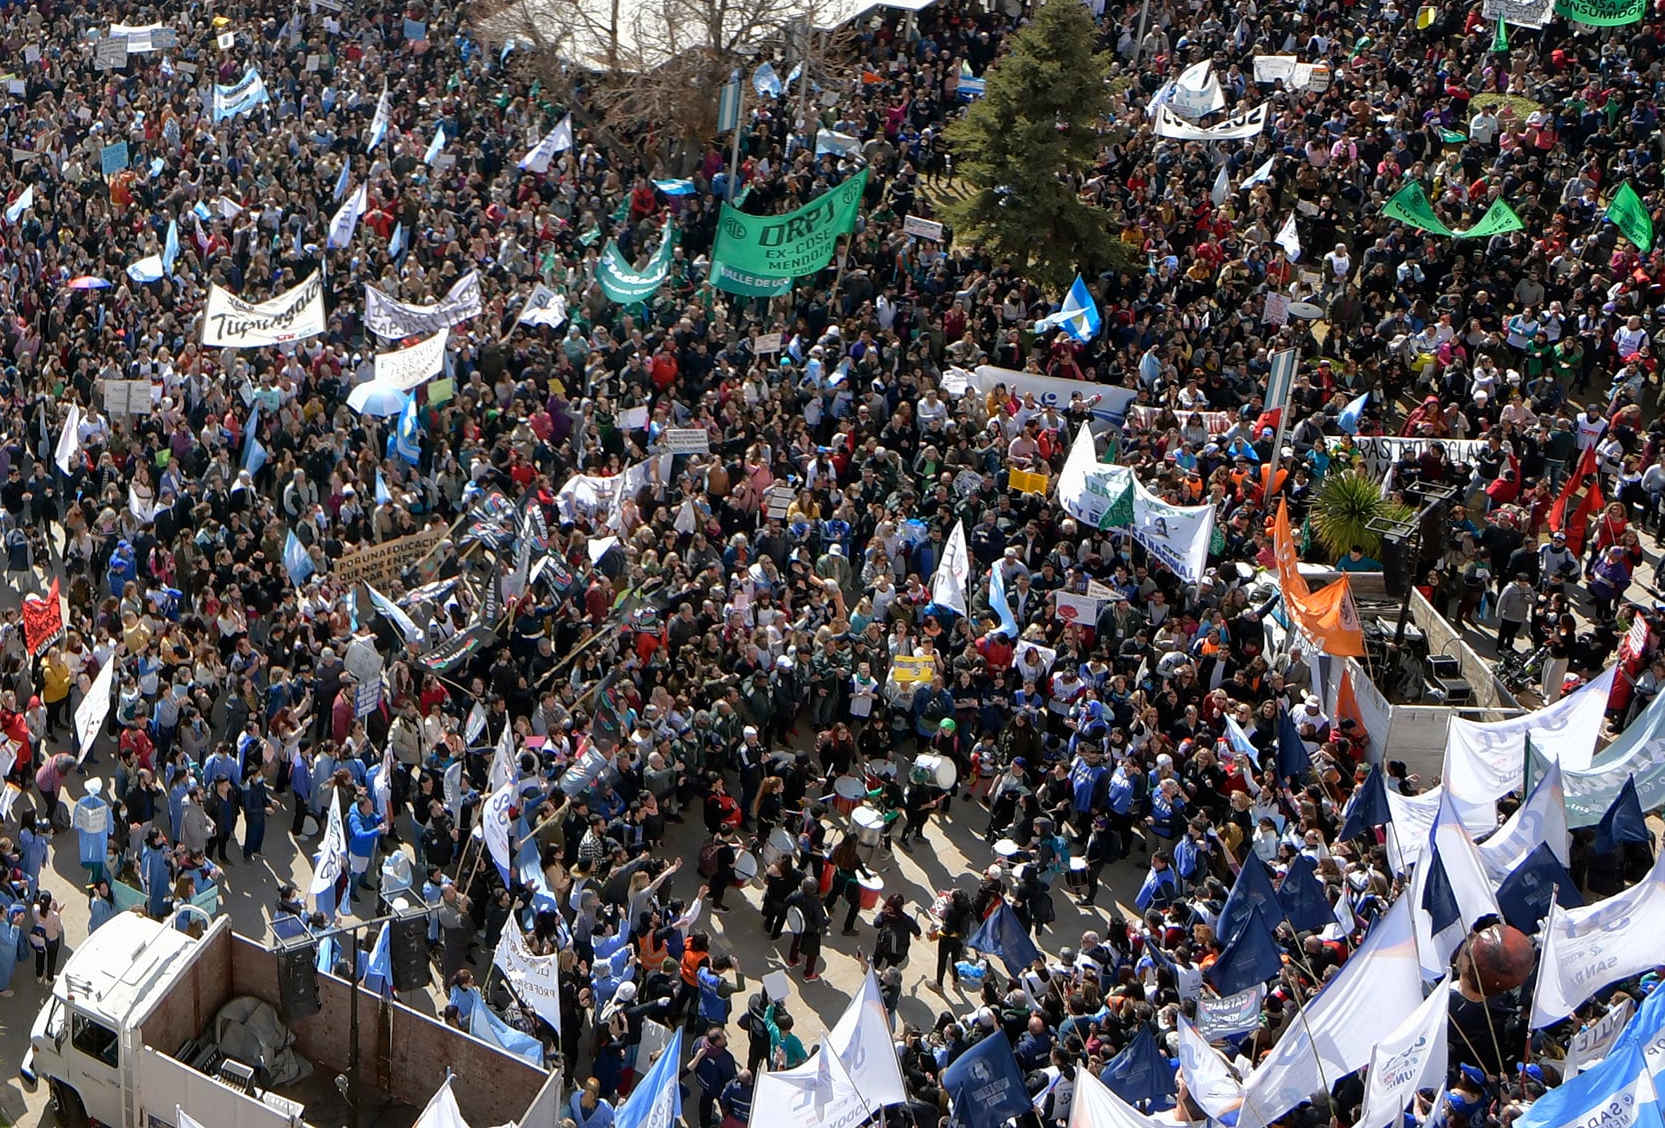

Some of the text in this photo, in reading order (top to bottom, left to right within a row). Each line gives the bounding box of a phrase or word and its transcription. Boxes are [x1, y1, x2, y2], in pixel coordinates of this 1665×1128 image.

[765, 227, 831, 259] EX-COSE
[768, 242, 832, 270] MENDOZA
[720, 266, 791, 288] VALLE DE UCO
[339, 557, 360, 571] POR
[362, 550, 386, 563] UNA
[339, 567, 360, 581] QUE
[362, 561, 385, 575] NOS
